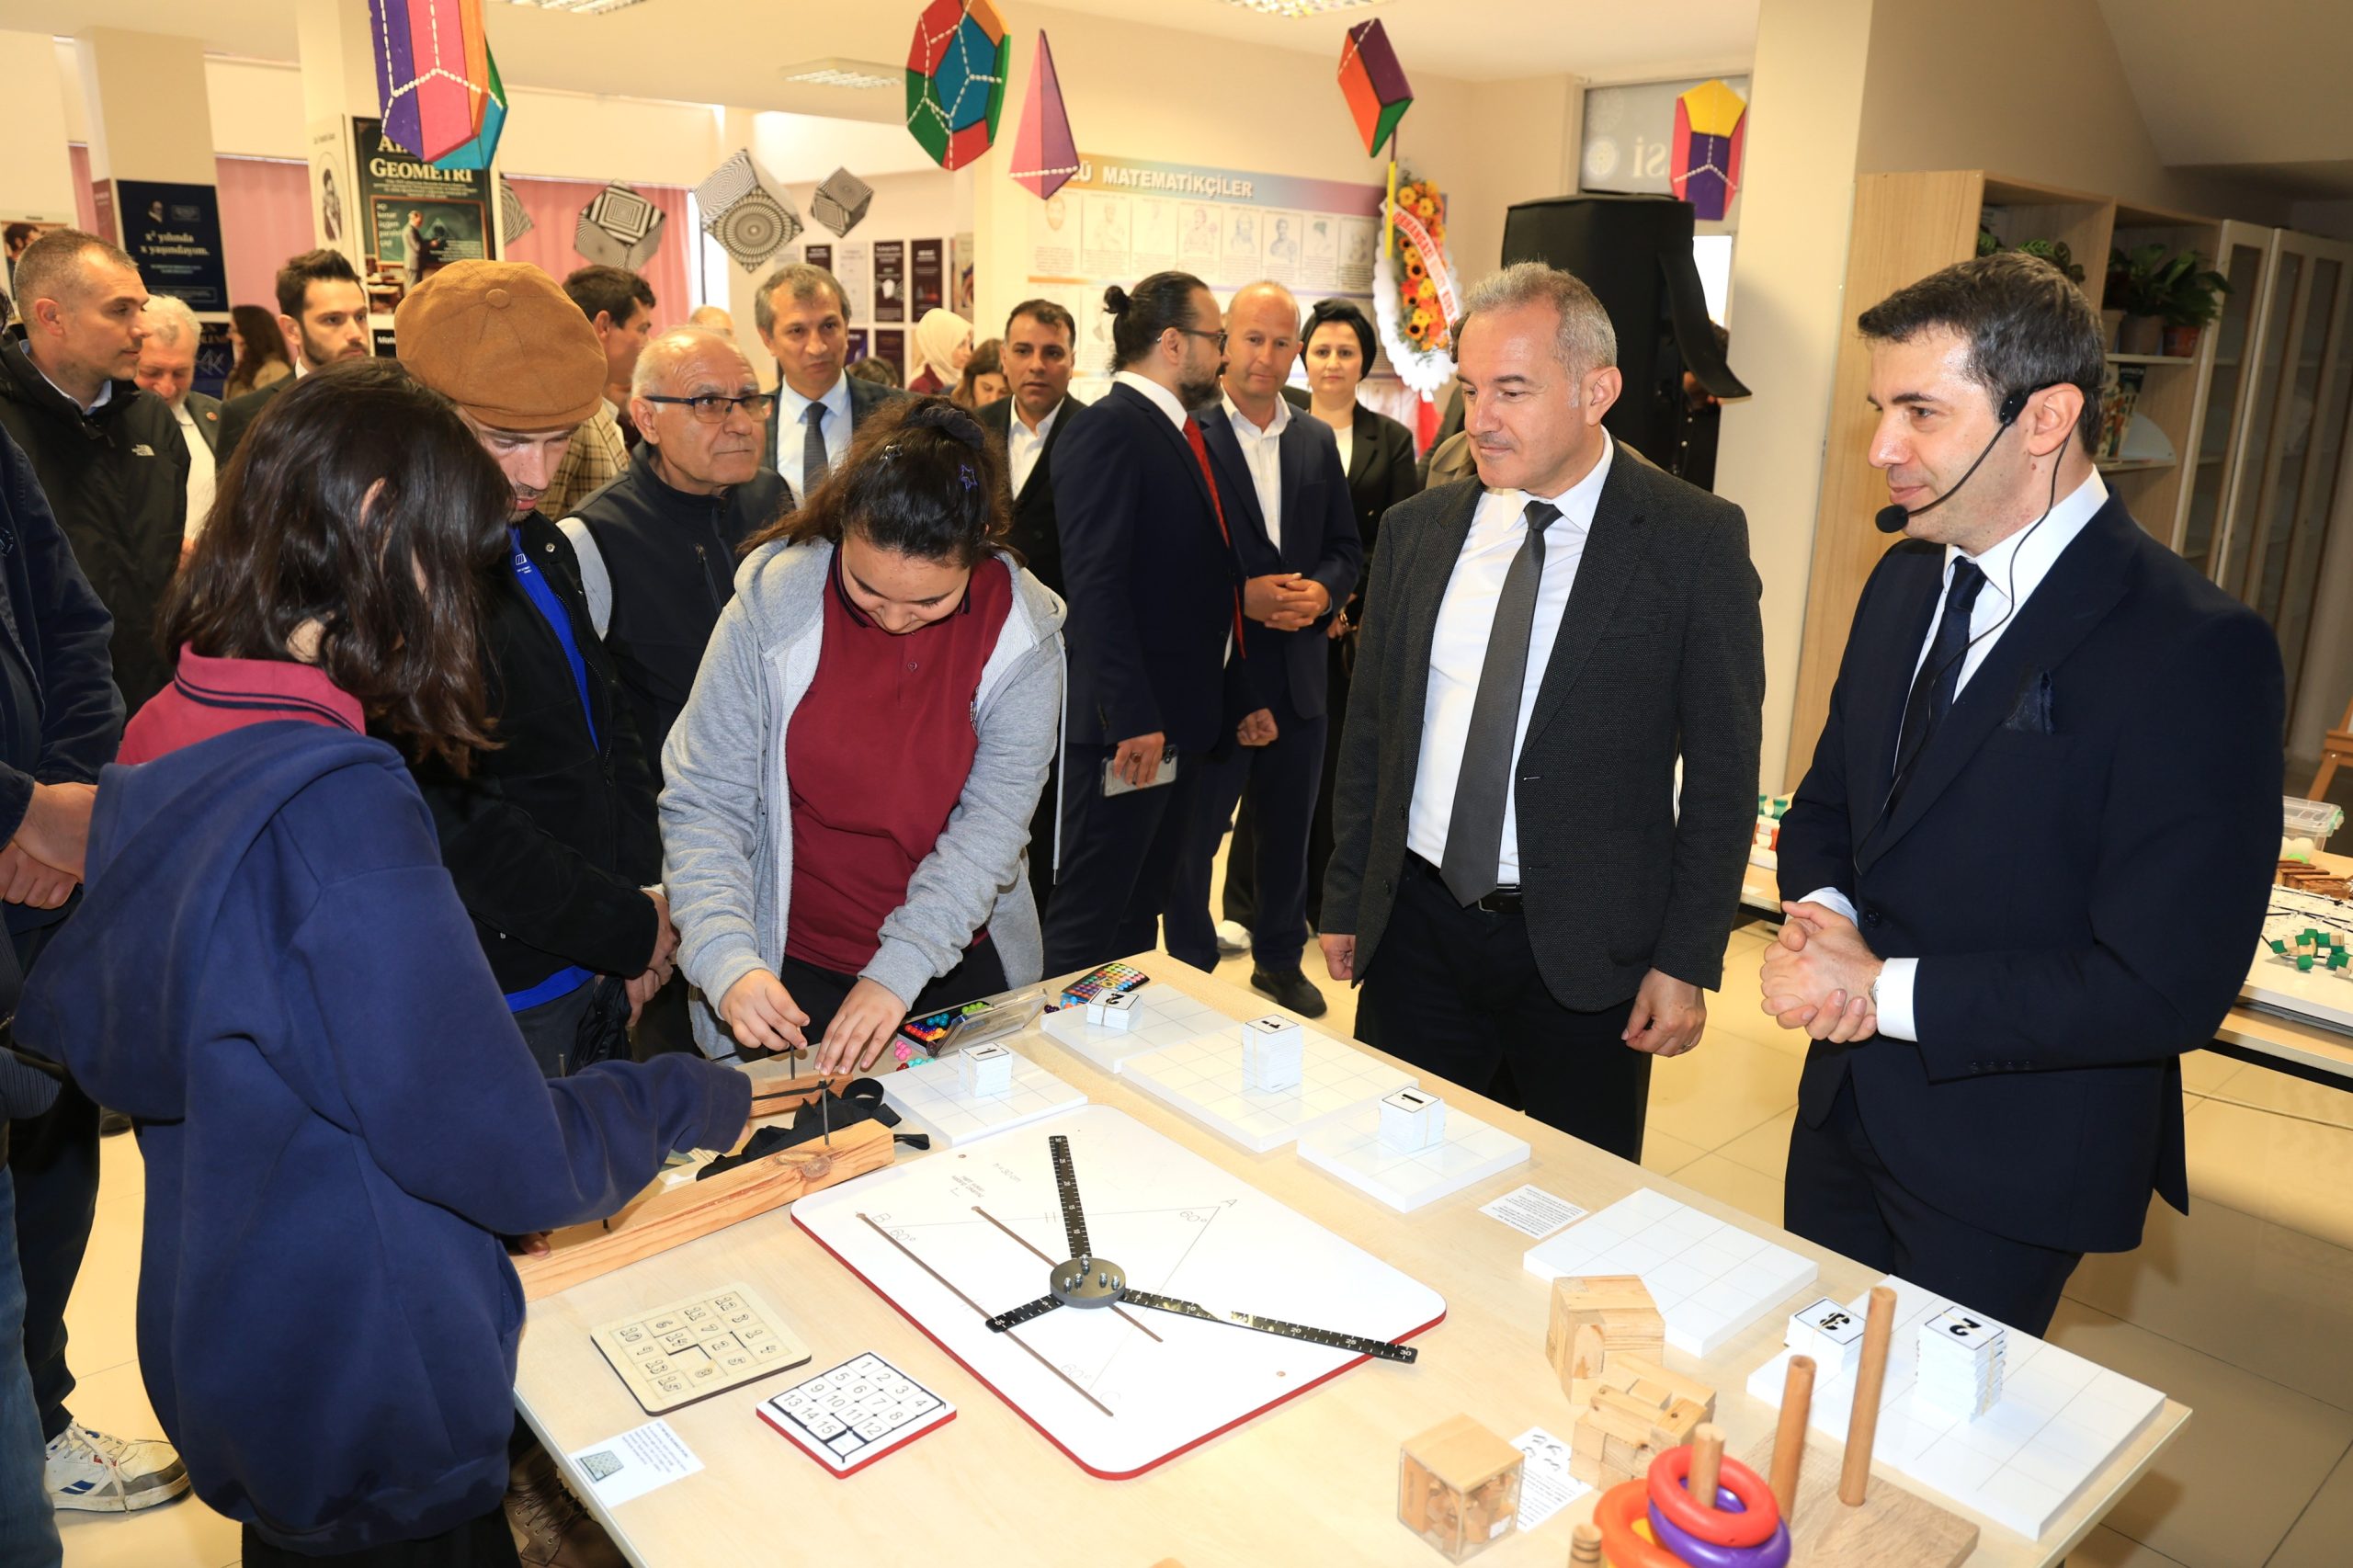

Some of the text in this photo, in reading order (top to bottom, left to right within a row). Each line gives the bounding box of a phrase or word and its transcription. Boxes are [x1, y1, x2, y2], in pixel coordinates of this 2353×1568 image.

[1103, 166, 1254, 199] MATEMATİKÇİLER
[1949, 1317, 1982, 1336] 2
[835, 1372, 904, 1420] 5 6 7 8
[877, 1373, 892, 1381] 2
[895, 1385, 909, 1394] 3
[915, 1399, 927, 1407] 4
[783, 1394, 837, 1435] 13 14 15
[811, 1384, 882, 1436] 9 10 11 12
